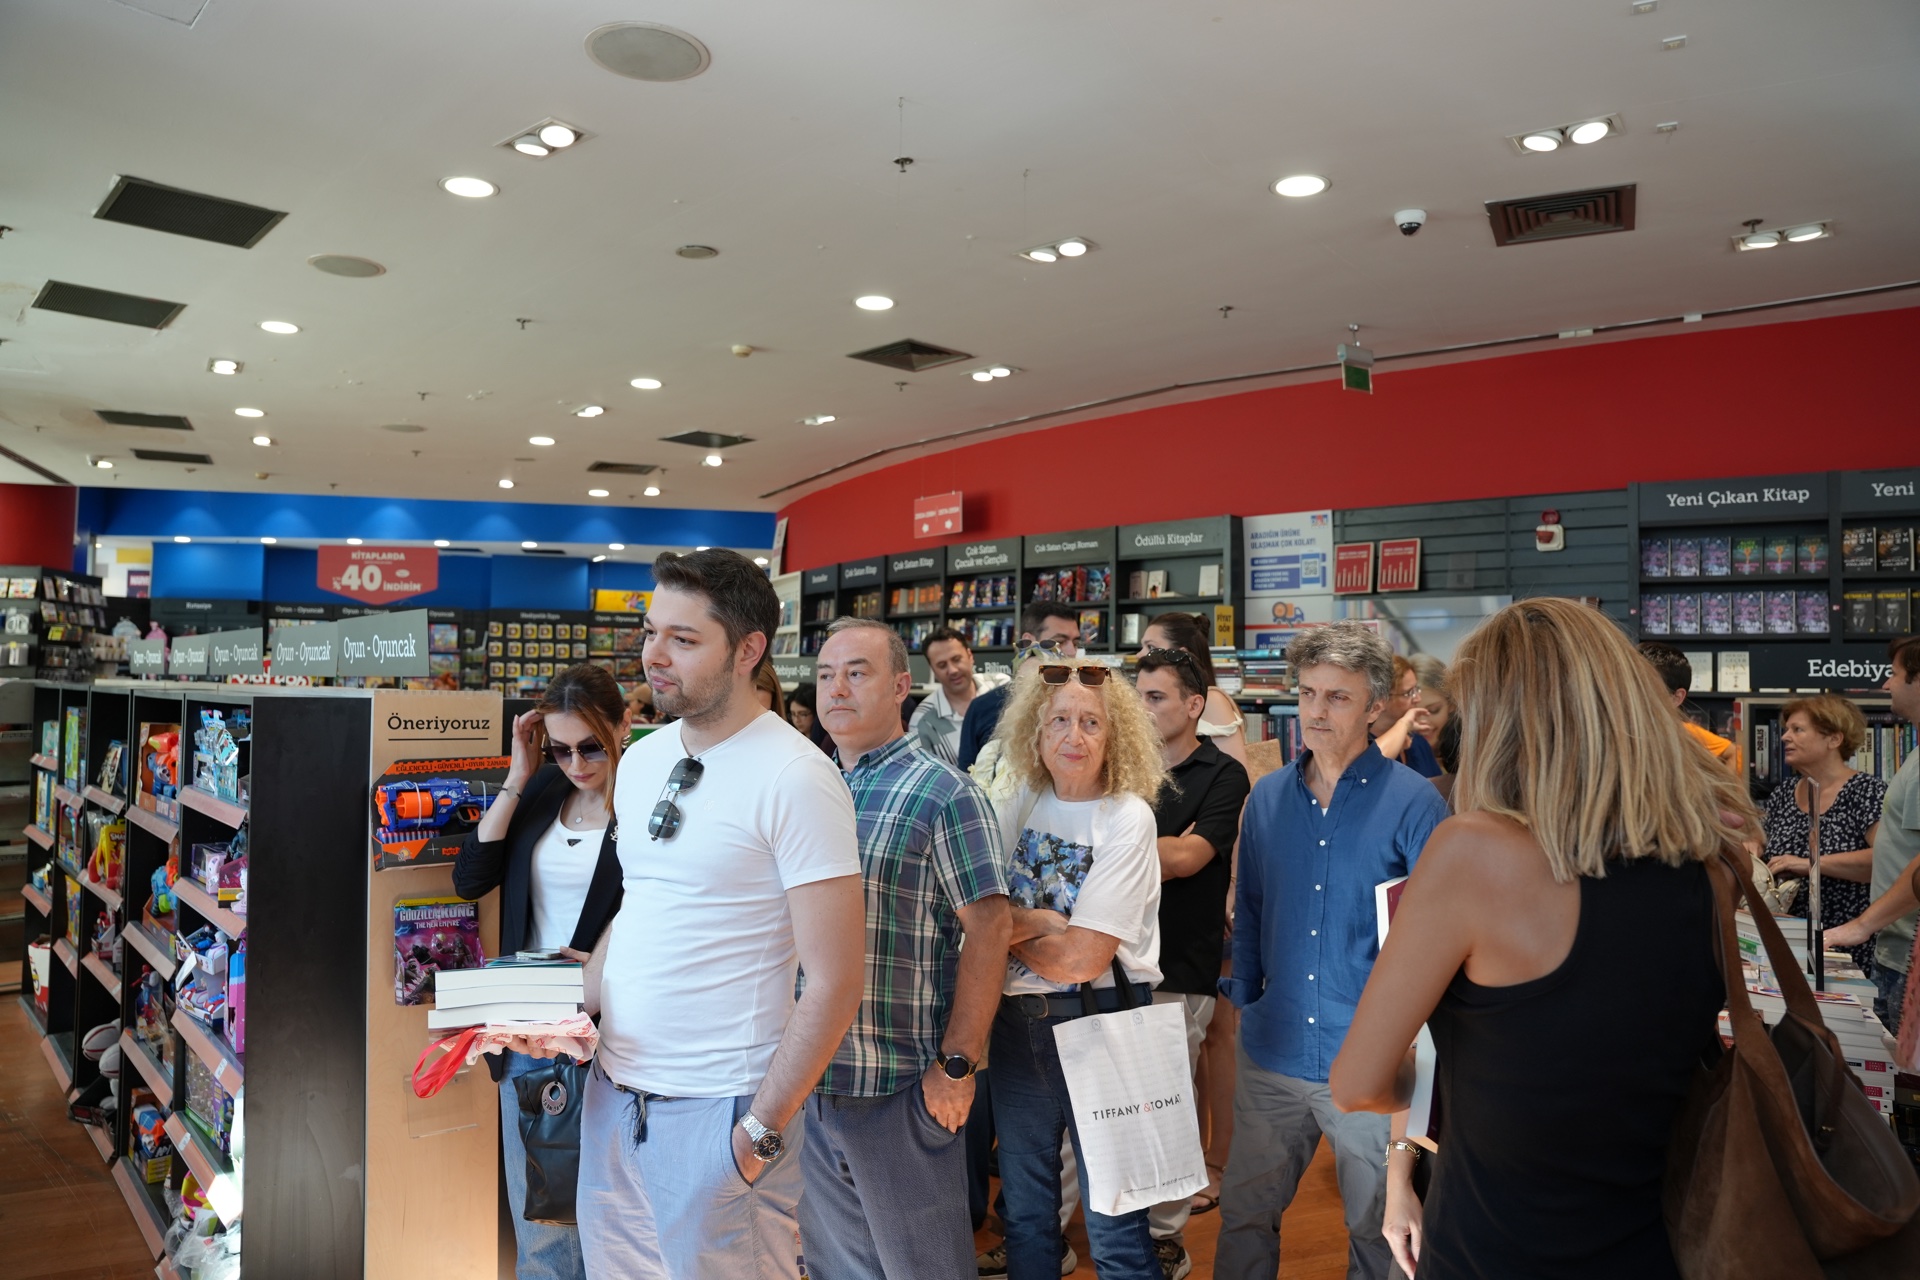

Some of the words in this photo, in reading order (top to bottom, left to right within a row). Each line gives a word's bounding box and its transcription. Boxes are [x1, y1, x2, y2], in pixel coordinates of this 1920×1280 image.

[1666, 492, 1703, 507] Yeni
[1707, 489, 1759, 508] Çıkan
[1762, 488, 1810, 504] Kitap
[1872, 481, 1915, 497] Yeni
[1135, 533, 1166, 547] Ödüllü
[1166, 532, 1204, 546] Kitaplar
[351, 549, 405, 561] KİTAPLARDA
[383, 580, 422, 592] İNDİRİM
[173, 649, 186, 667] Oyun
[187, 647, 206, 667] Oyuncak
[214, 646, 230, 667] Oyun
[233, 643, 258, 666] Oyuncak
[276, 643, 295, 666] Oyun
[299, 640, 332, 666] Oyuncak
[343, 636, 366, 664] Oyun
[372, 633, 416, 664] Oyuncak
[1807, 659, 1894, 682] Edebiya
[387, 712, 490, 733] Öneriyoruz
[395, 763, 433, 772] EĞLENCELİ
[437, 761, 465, 770] GÜVENLİ
[414, 921, 426, 929] THE
[1092, 1104, 1140, 1121] TIFFANY
